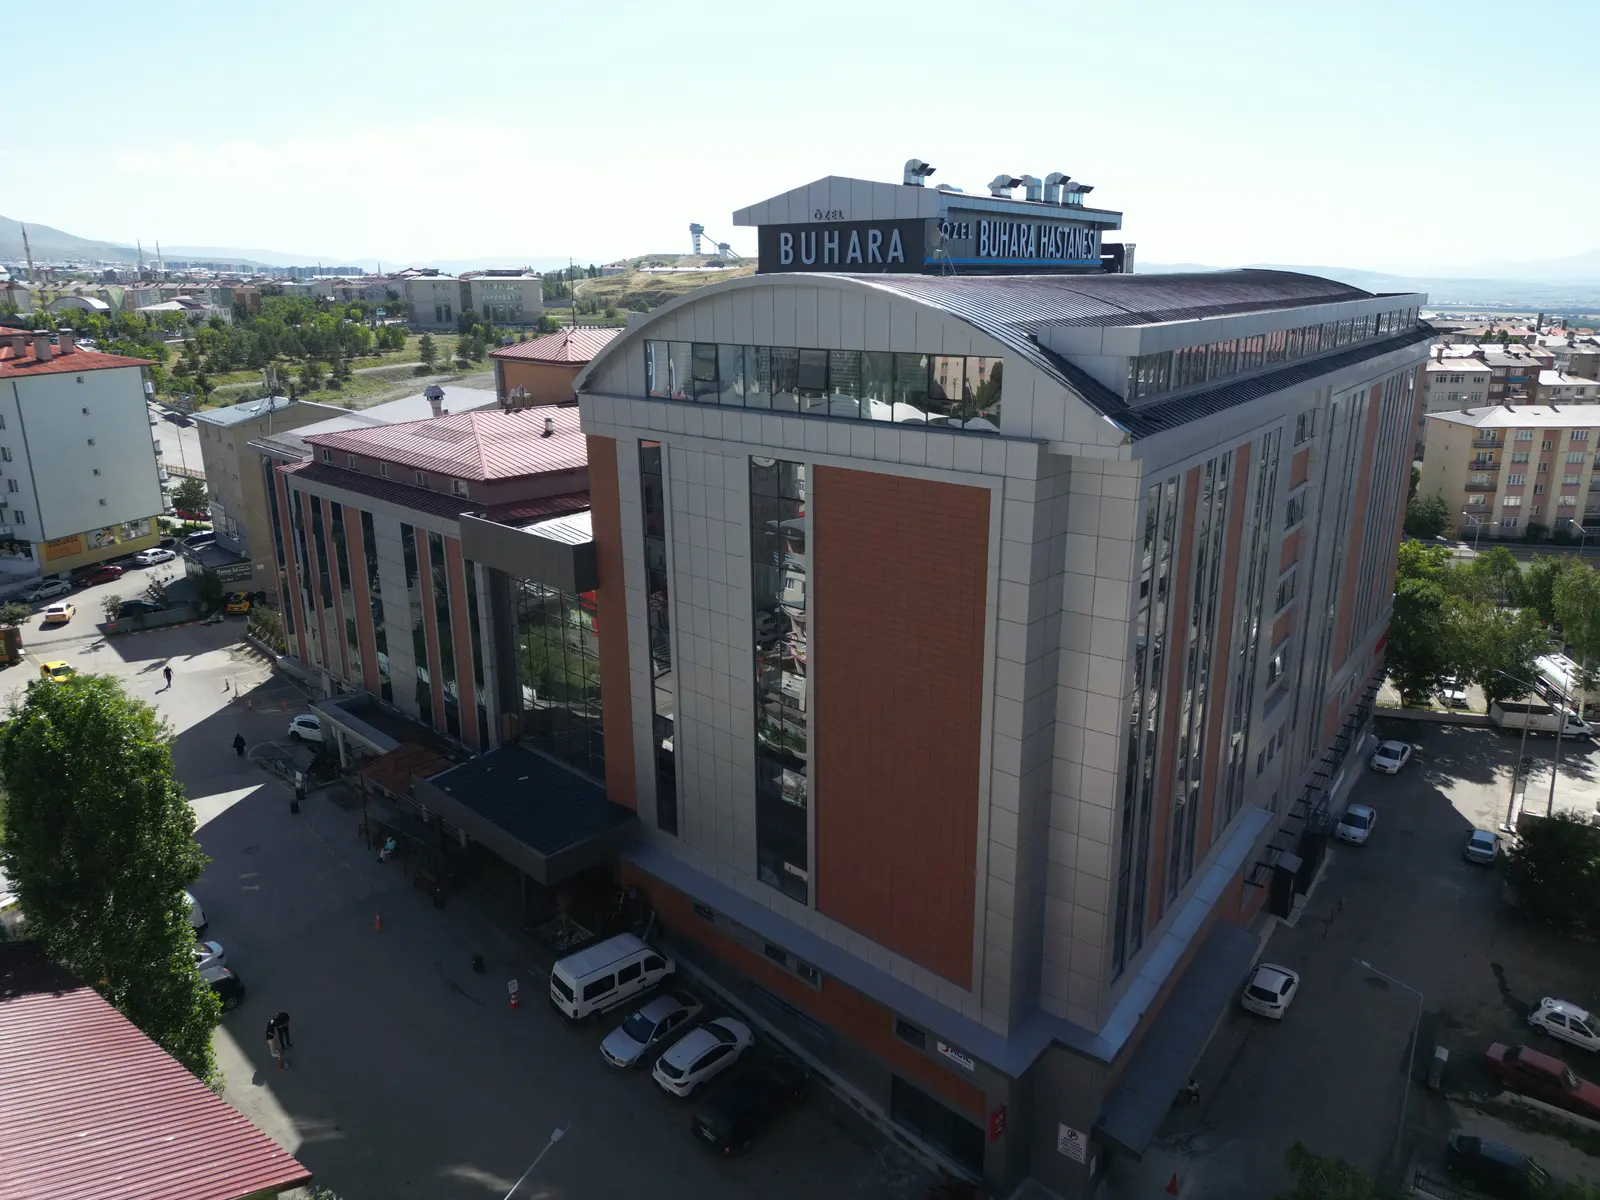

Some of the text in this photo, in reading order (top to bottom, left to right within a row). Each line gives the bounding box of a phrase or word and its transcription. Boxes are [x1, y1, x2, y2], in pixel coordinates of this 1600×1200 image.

[814, 209, 844, 220] ÖZEL
[780, 228, 905, 265] BUHARA
[941, 218, 1098, 259] ÖZEL BUHARA HASTANESİ
